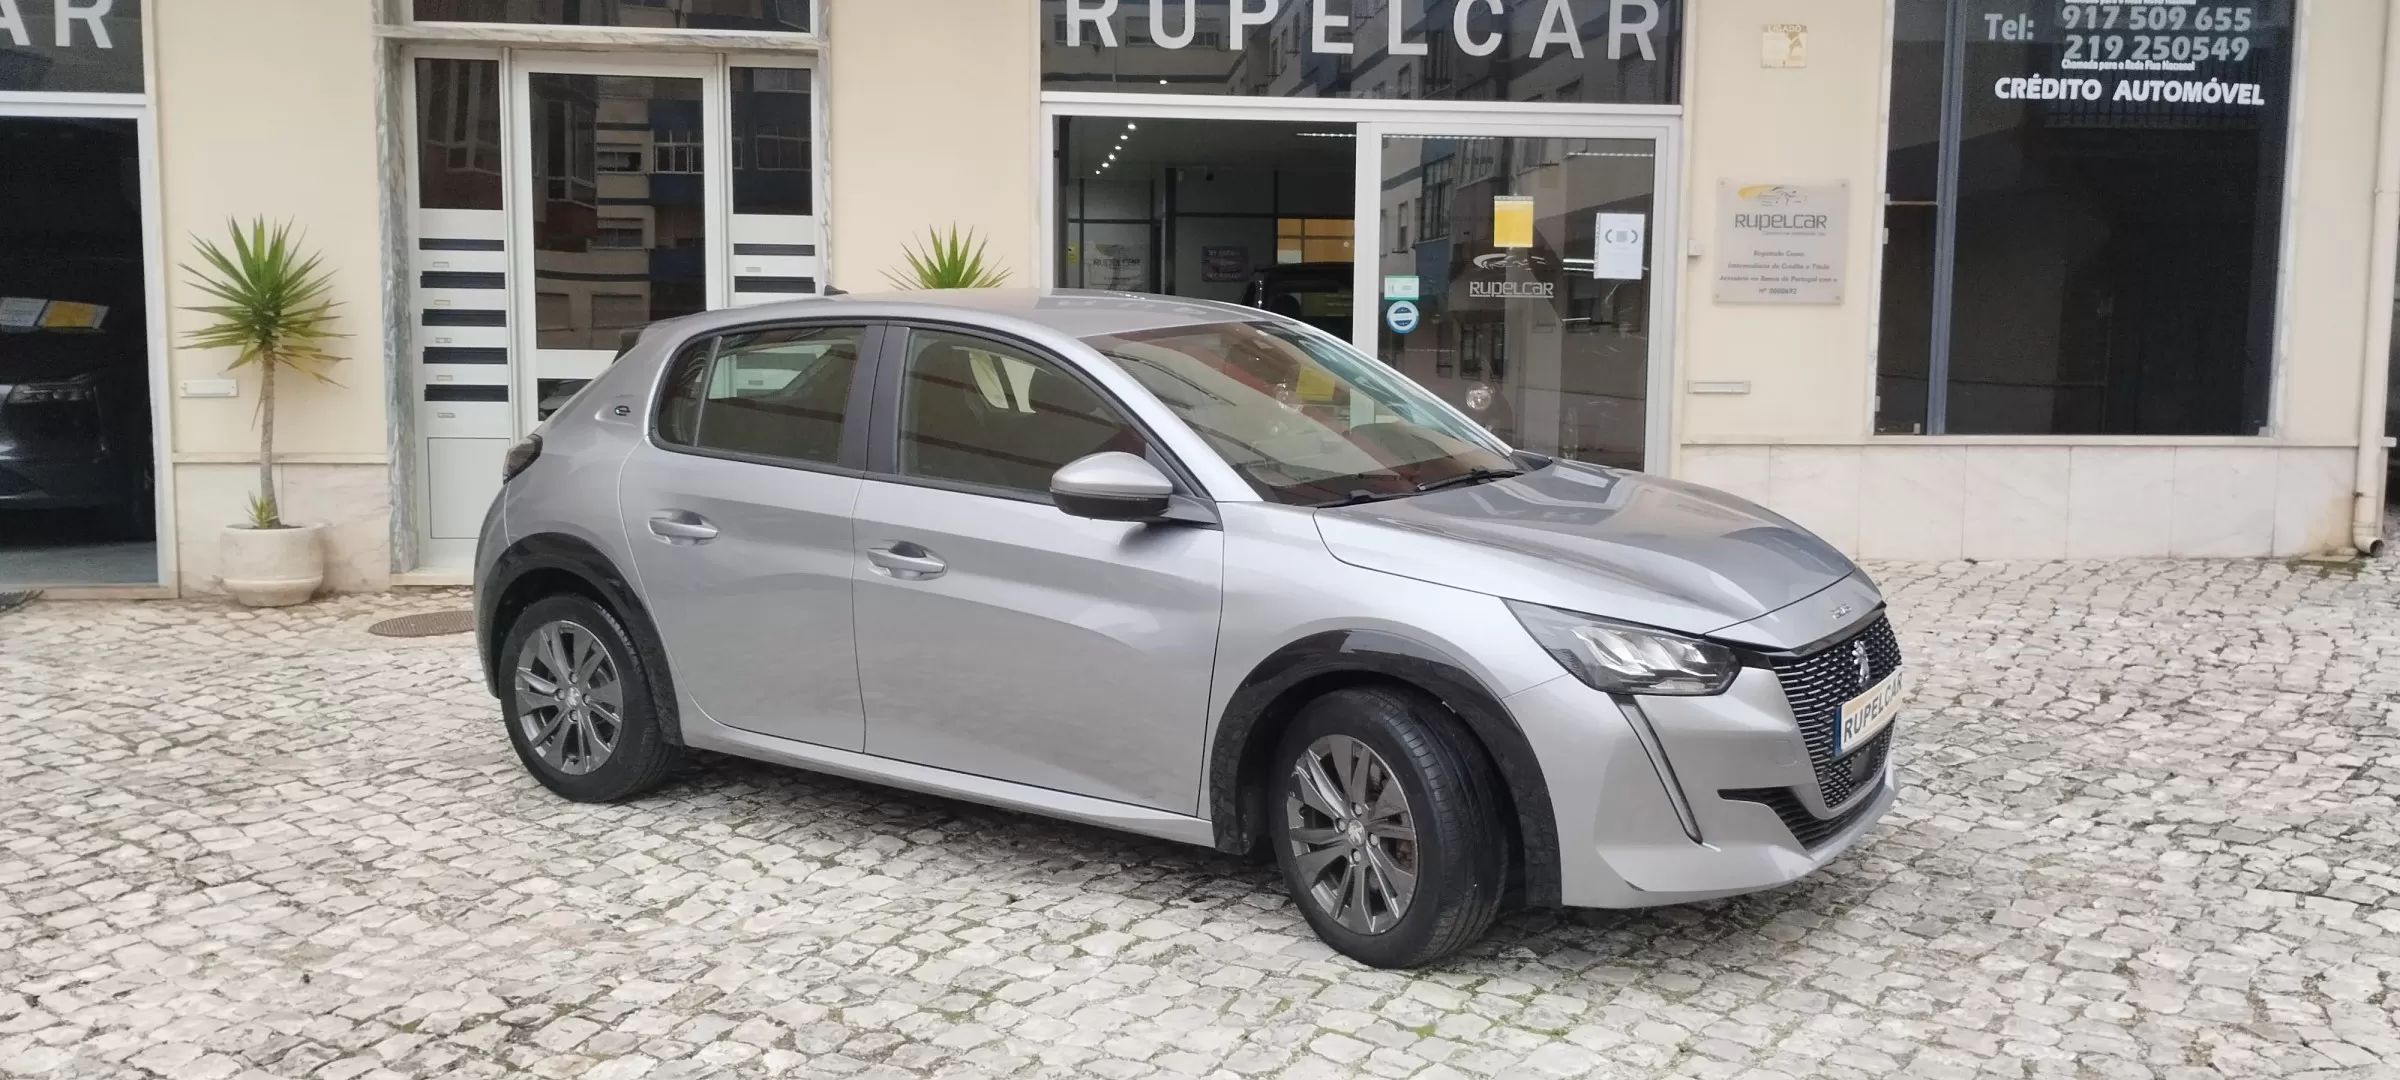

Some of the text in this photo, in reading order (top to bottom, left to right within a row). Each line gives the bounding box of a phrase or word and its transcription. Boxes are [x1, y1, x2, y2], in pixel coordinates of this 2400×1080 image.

[1066, 0, 1661, 61] RUPELCAR
[1984, 13, 2035, 41] Tel:
[2062, 5, 2252, 31] 917 509 655
[2063, 35, 2250, 61] 219 250549
[1994, 73, 2265, 105] CRÉDITO AUTOMÓVEL
[1844, 672, 1902, 743] RUPELCAR
